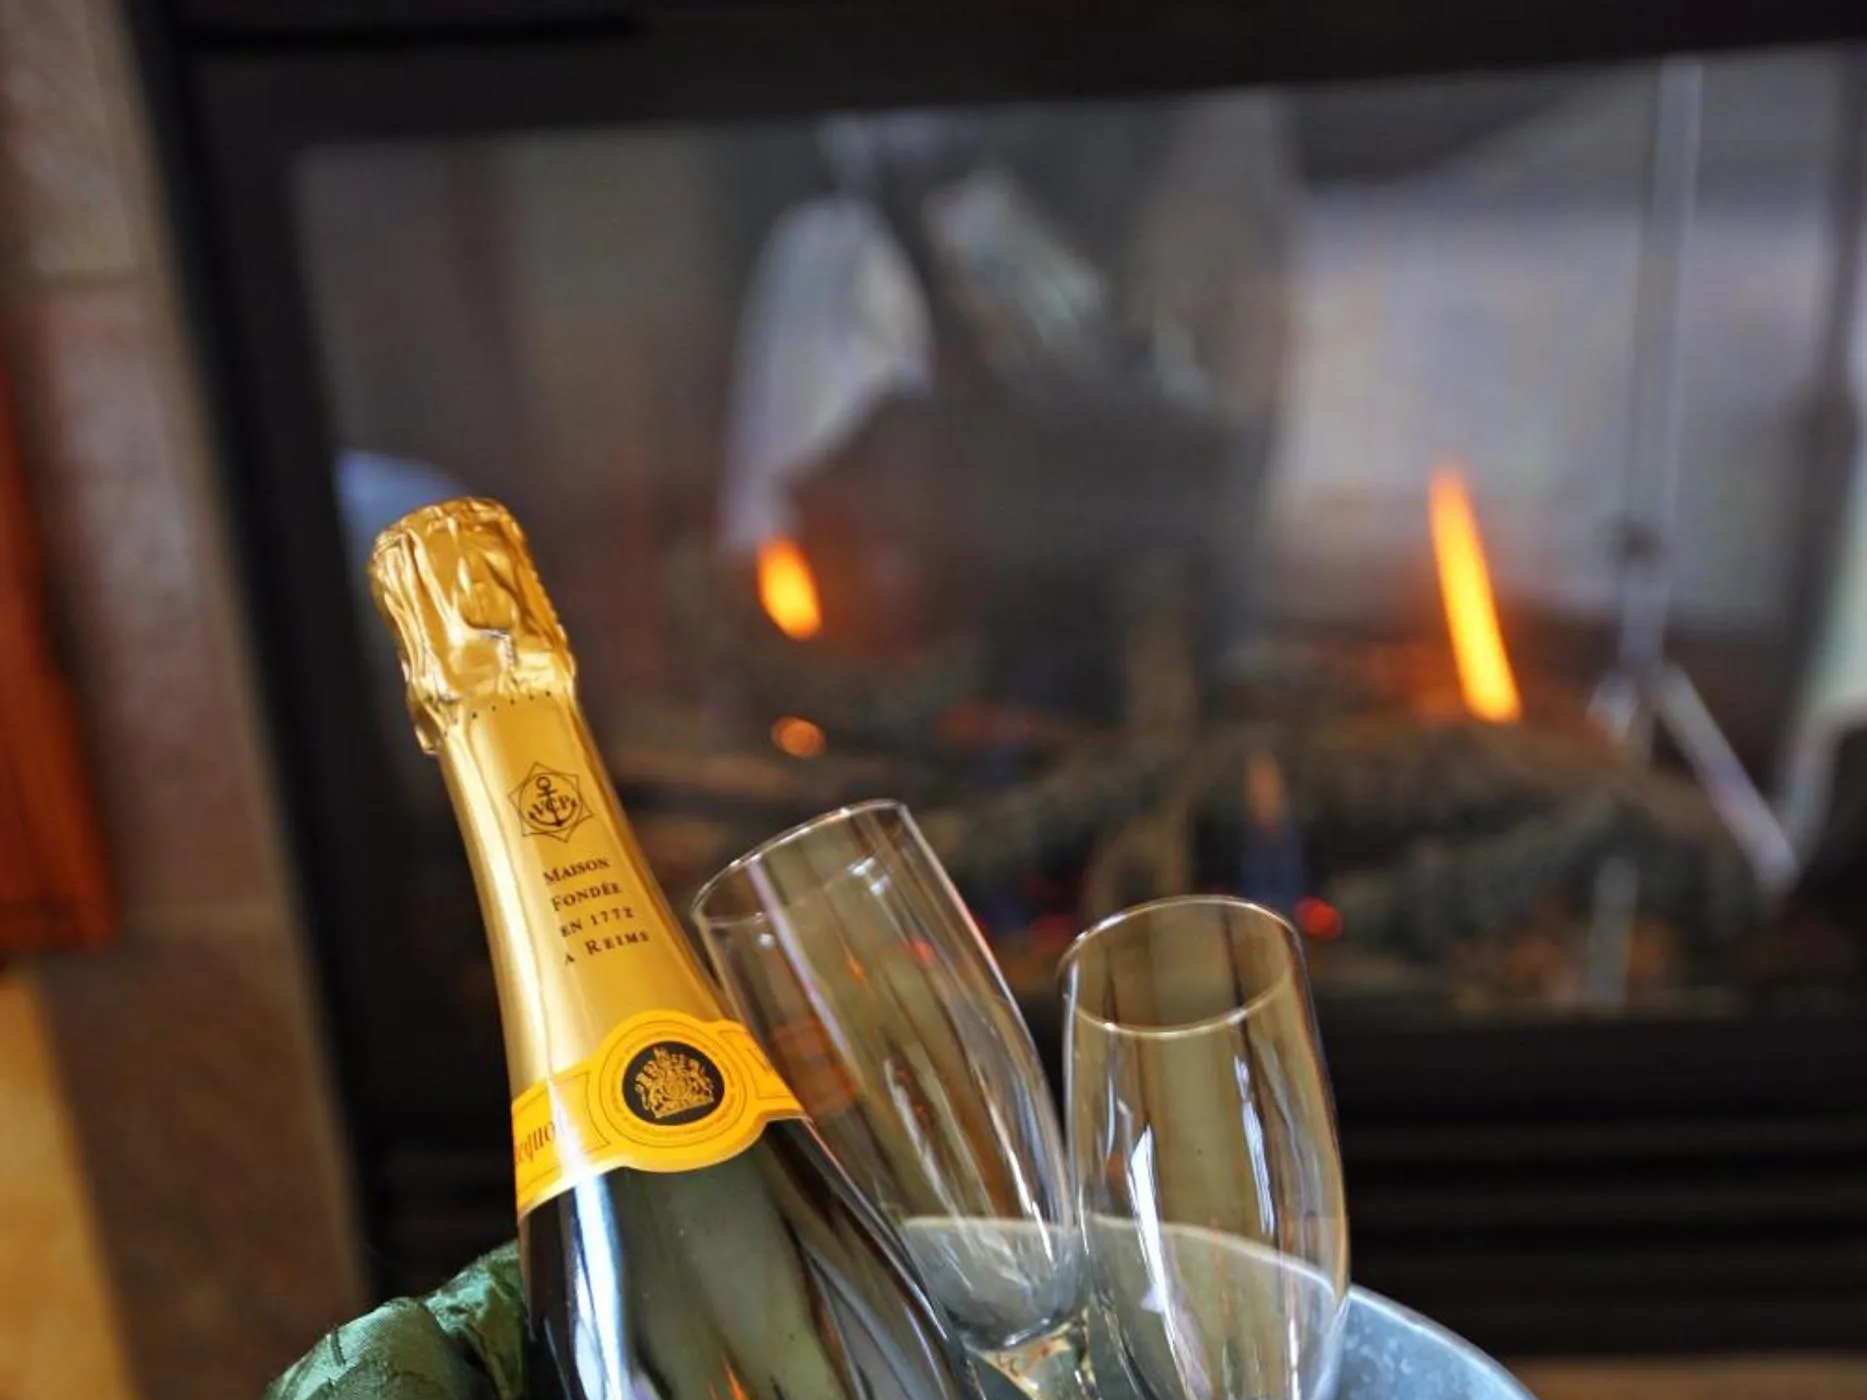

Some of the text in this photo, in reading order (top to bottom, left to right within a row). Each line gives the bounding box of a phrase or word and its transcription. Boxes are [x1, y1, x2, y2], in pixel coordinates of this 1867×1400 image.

[543, 858, 610, 882] MAISON
[561, 907, 634, 937] EN 1772
[585, 931, 649, 955] REIMS
